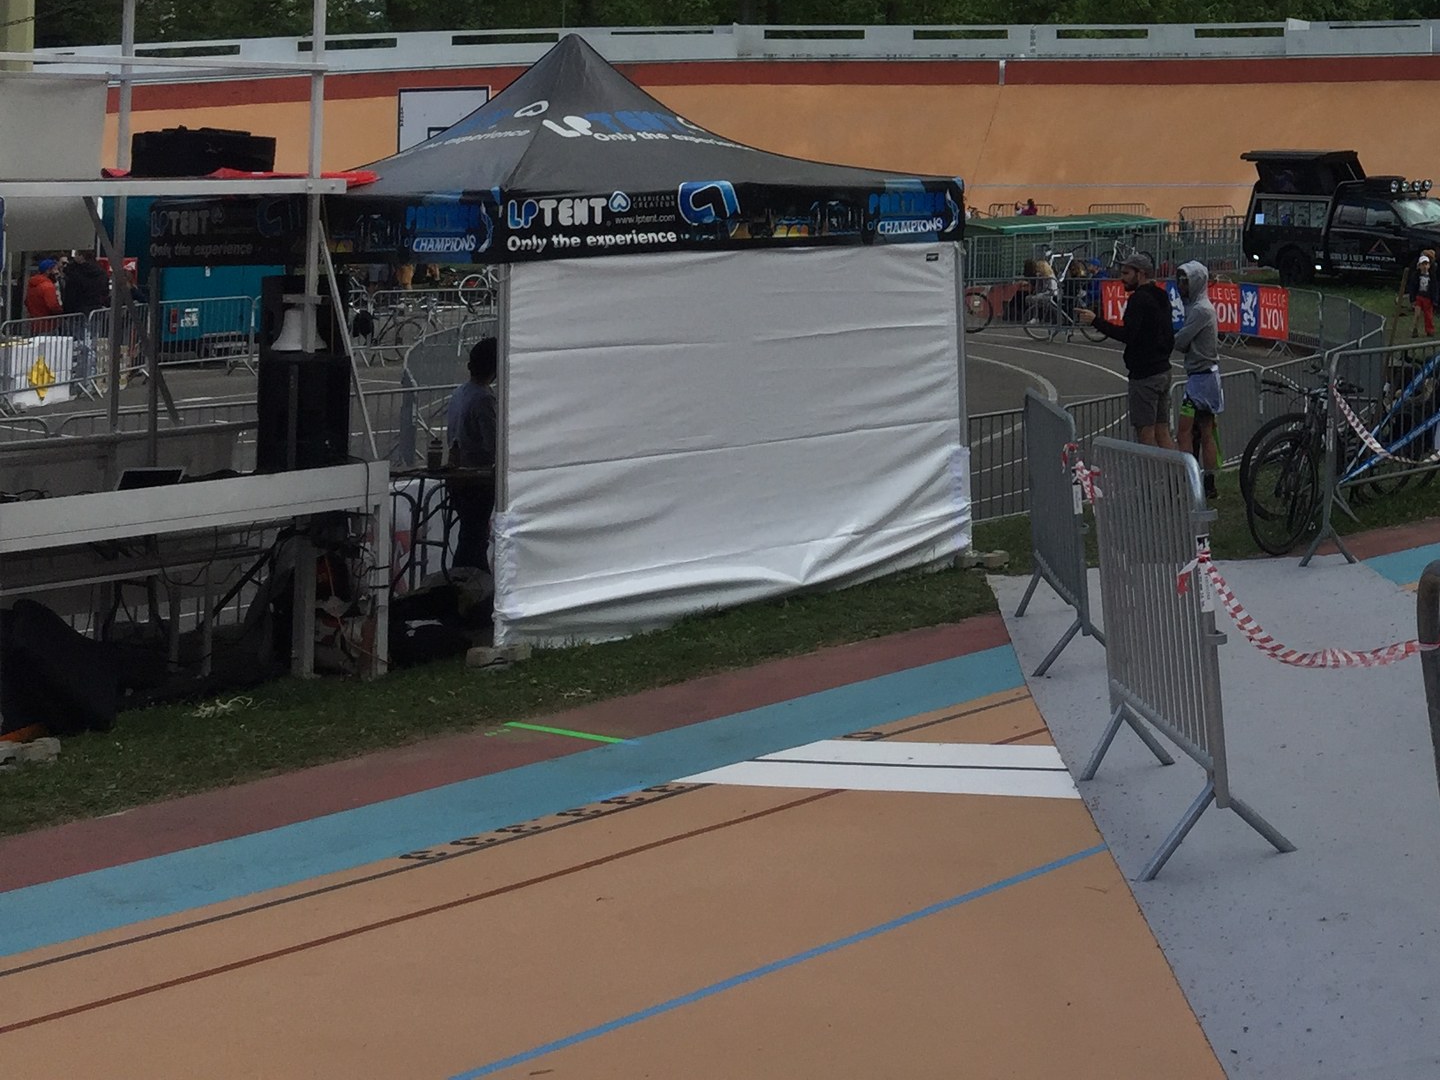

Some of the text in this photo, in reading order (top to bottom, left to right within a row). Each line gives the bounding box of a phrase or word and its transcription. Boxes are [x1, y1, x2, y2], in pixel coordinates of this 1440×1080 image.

[593, 132, 637, 142] Only
[636, 131, 669, 140] the
[615, 214, 676, 226] www.lptent.com
[877, 217, 944, 235] CHAMPIONS
[412, 234, 478, 253] CHAMPIONS
[506, 234, 548, 253] Only
[551, 233, 581, 248] the
[586, 229, 678, 248] experience
[1261, 307, 1285, 332] LYON
